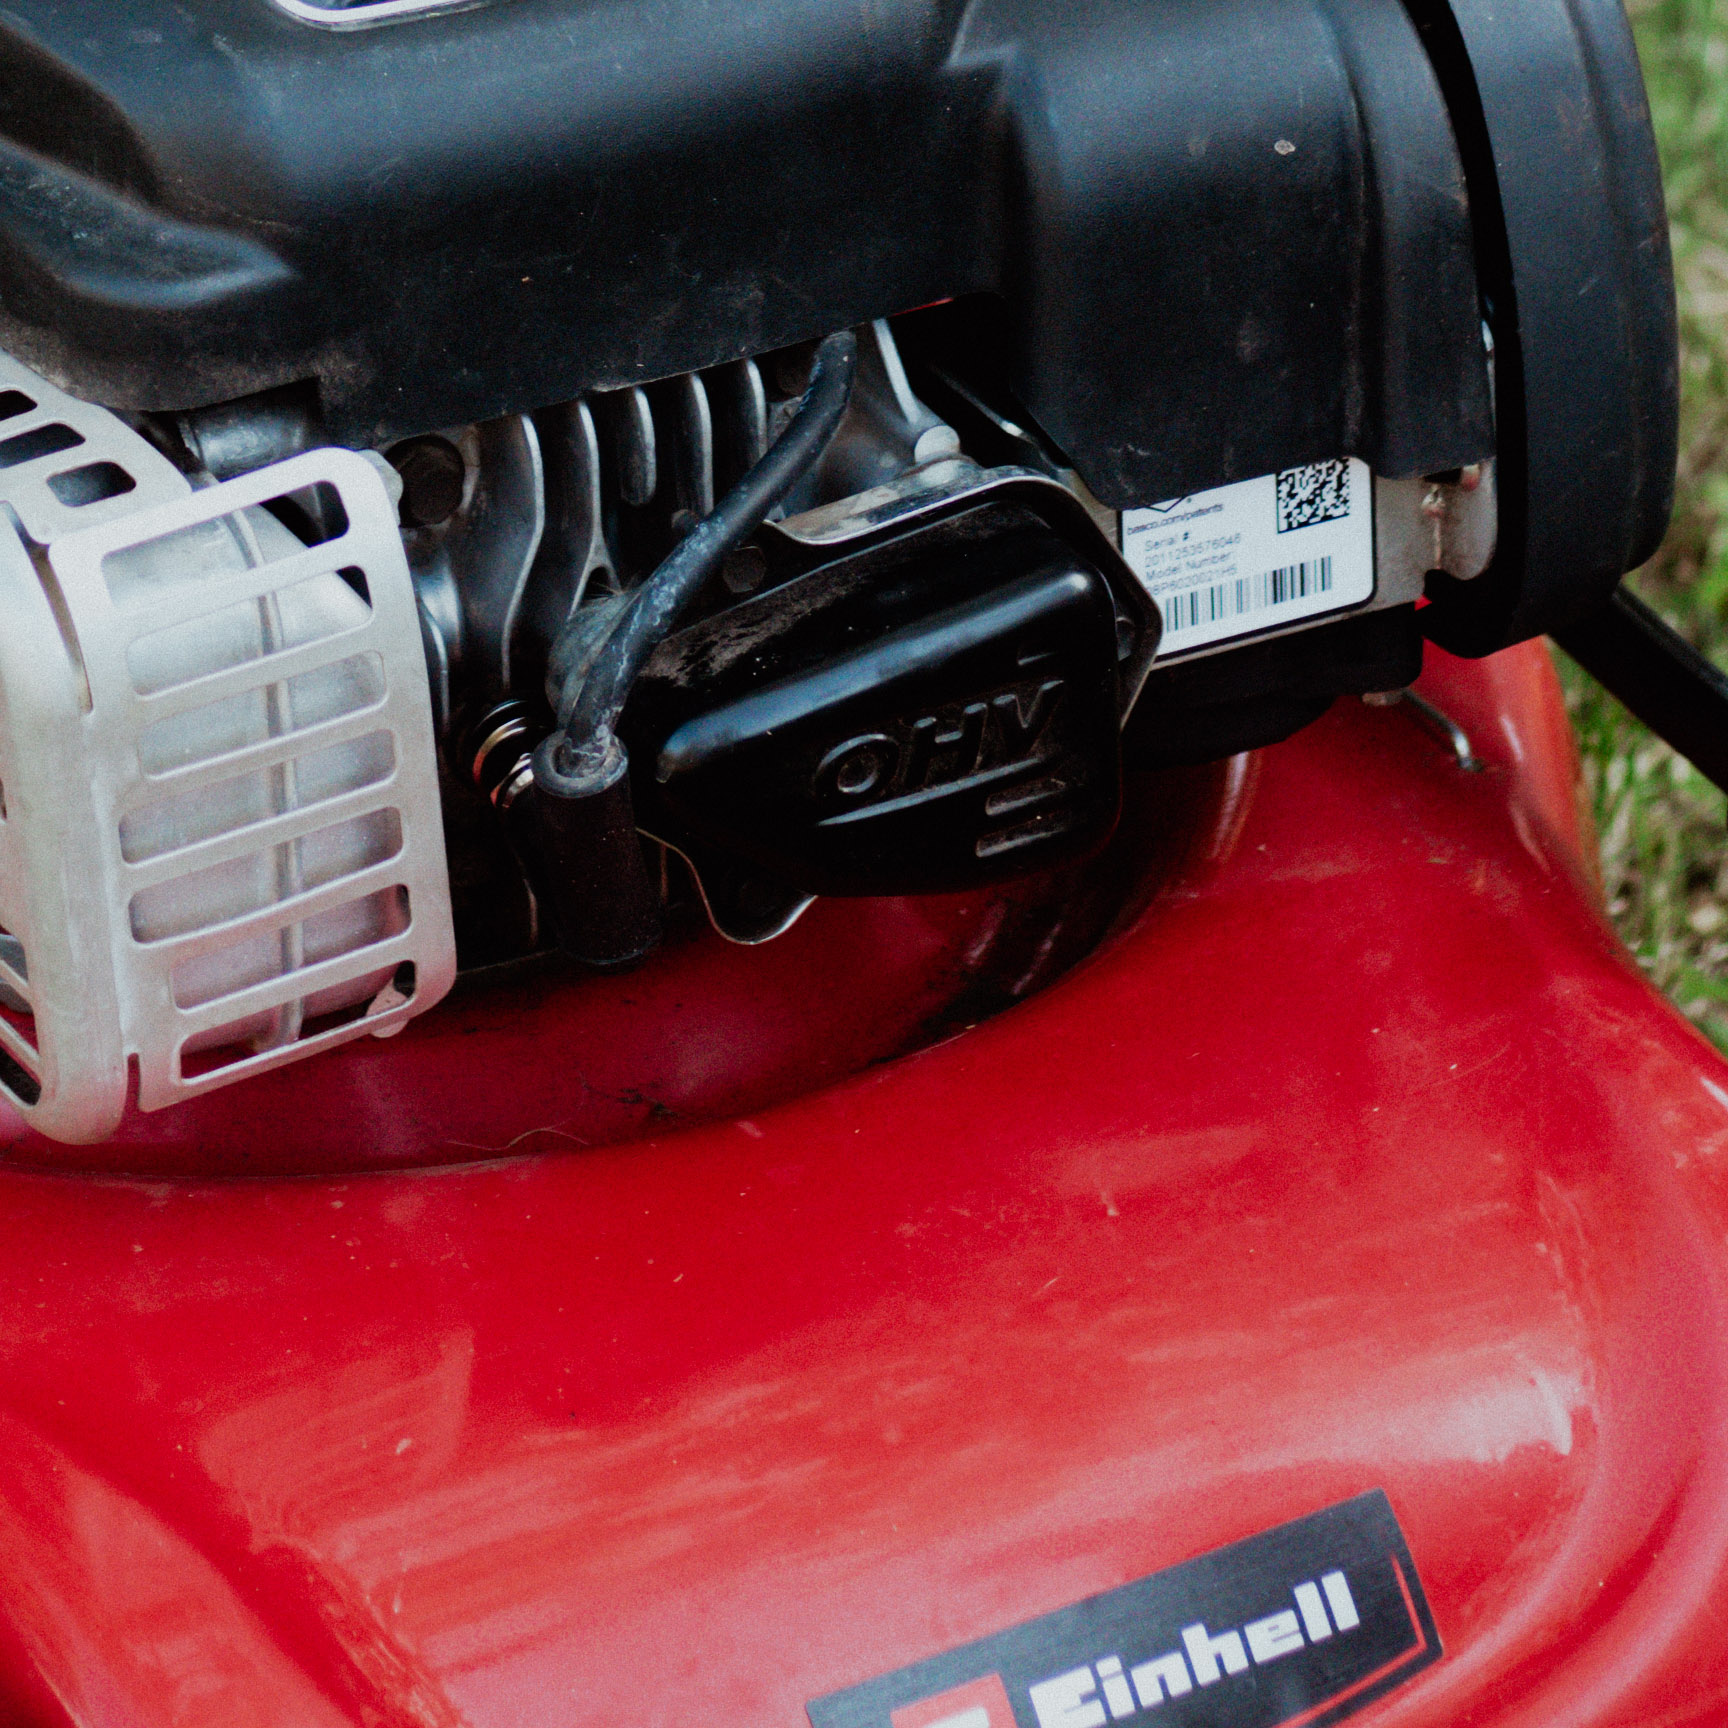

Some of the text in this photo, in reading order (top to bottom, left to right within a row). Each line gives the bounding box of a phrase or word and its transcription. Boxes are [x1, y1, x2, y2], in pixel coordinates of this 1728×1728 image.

[1186, 551, 1233, 569] Number
[815, 680, 1064, 799] OHV
[1028, 1570, 1361, 1728] Einhell
